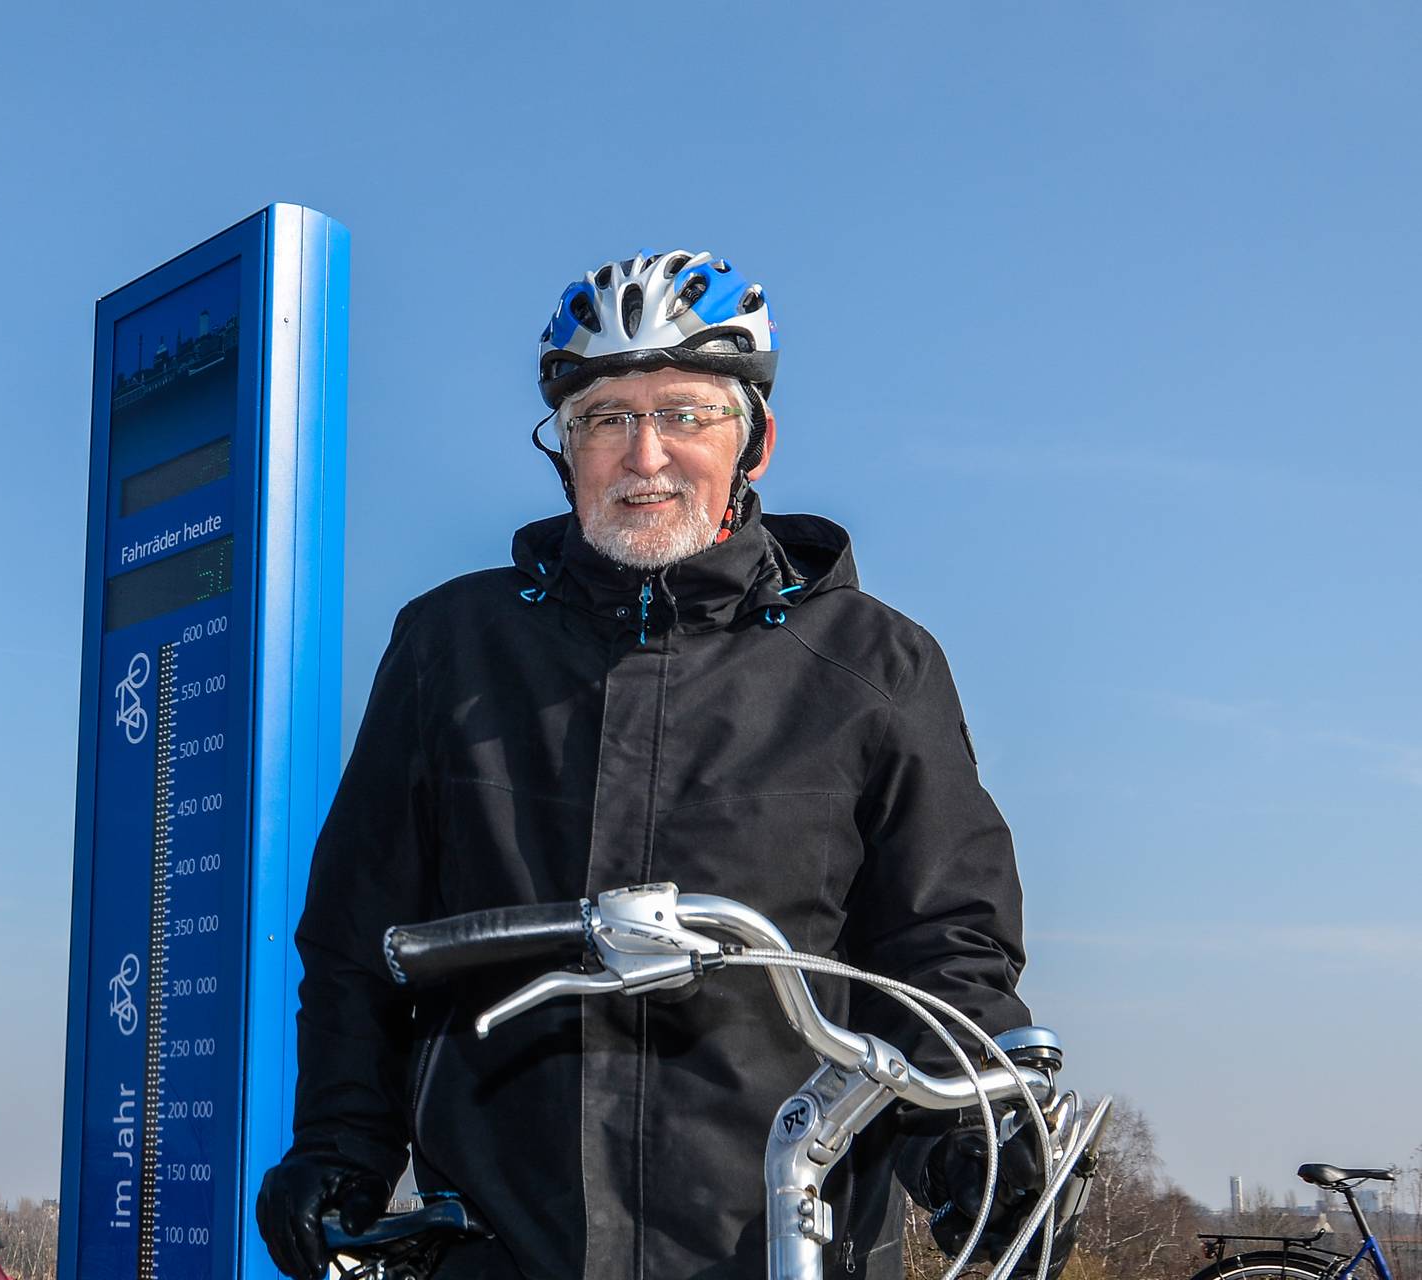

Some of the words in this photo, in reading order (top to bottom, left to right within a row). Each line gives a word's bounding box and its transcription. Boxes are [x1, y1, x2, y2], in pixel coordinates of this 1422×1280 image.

[122, 530, 181, 564] Fahrräder
[184, 516, 221, 541] heute
[183, 624, 202, 643] 600
[207, 616, 227, 635] 000
[182, 682, 200, 700] 550
[206, 674, 225, 693] 000
[180, 740, 199, 758] 500
[204, 734, 223, 752] 000
[178, 799, 197, 816] 450
[202, 793, 222, 812] 000
[175, 858, 195, 875] 400
[200, 854, 220, 872] 000
[174, 919, 193, 936] 350
[199, 915, 218, 933] 000
[172, 979, 191, 996] 300
[197, 977, 217, 994] 000
[170, 1040, 189, 1057] 250
[195, 1038, 215, 1056] 000
[168, 1102, 187, 1119] 200
[193, 1101, 213, 1118] 000
[113, 1083, 135, 1167] Jahr
[167, 1164, 185, 1180] 150
[191, 1164, 211, 1181] 000
[111, 1181, 132, 1227] im
[165, 1226, 183, 1243] 100
[189, 1227, 208, 1245] 000
